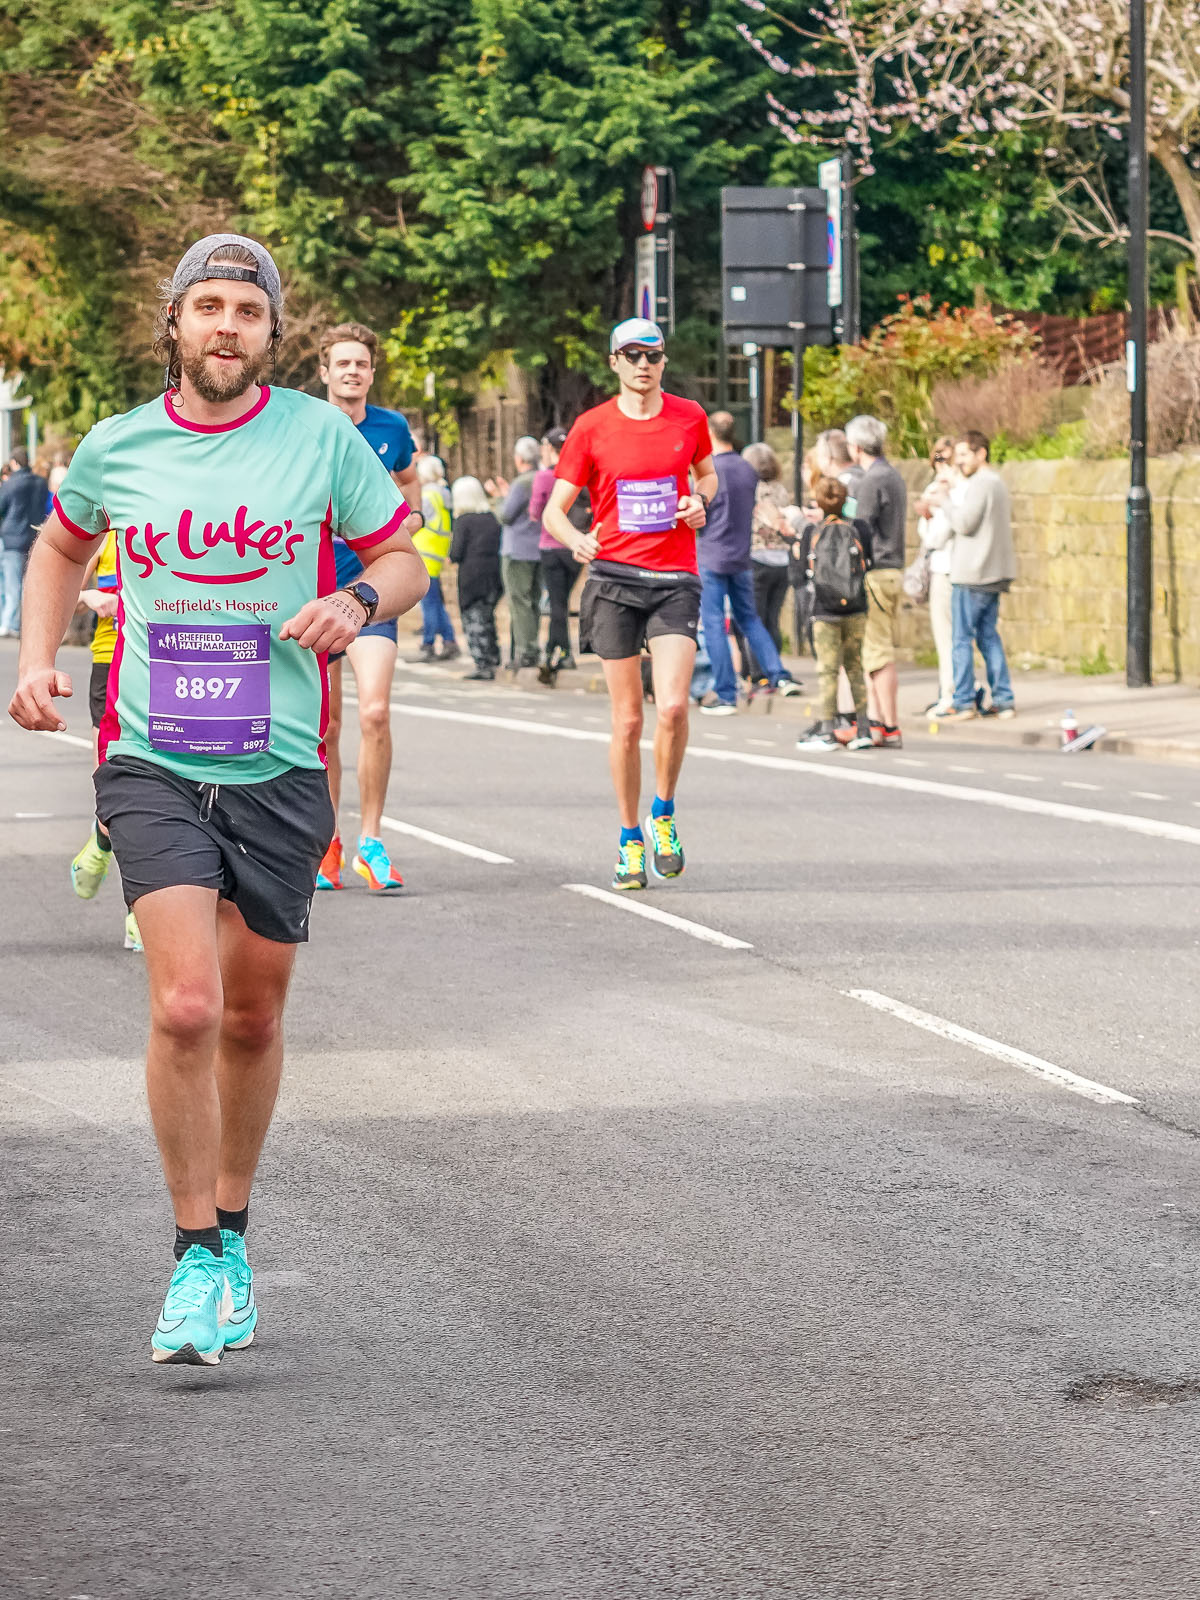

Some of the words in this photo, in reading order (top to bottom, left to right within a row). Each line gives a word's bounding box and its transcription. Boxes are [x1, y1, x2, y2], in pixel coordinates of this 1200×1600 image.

[125, 522, 171, 579] St
[177, 505, 305, 566] Luke's
[154, 599, 222, 614] Sheffield's
[226, 599, 278, 614] Hospice
[179, 633, 222, 642] SHEFFIELD
[180, 641, 202, 650] HALF
[203, 641, 256, 651] MARATHON
[233, 651, 257, 659] 2022
[175, 676, 243, 699] 8897
[243, 740, 264, 750] 8897
